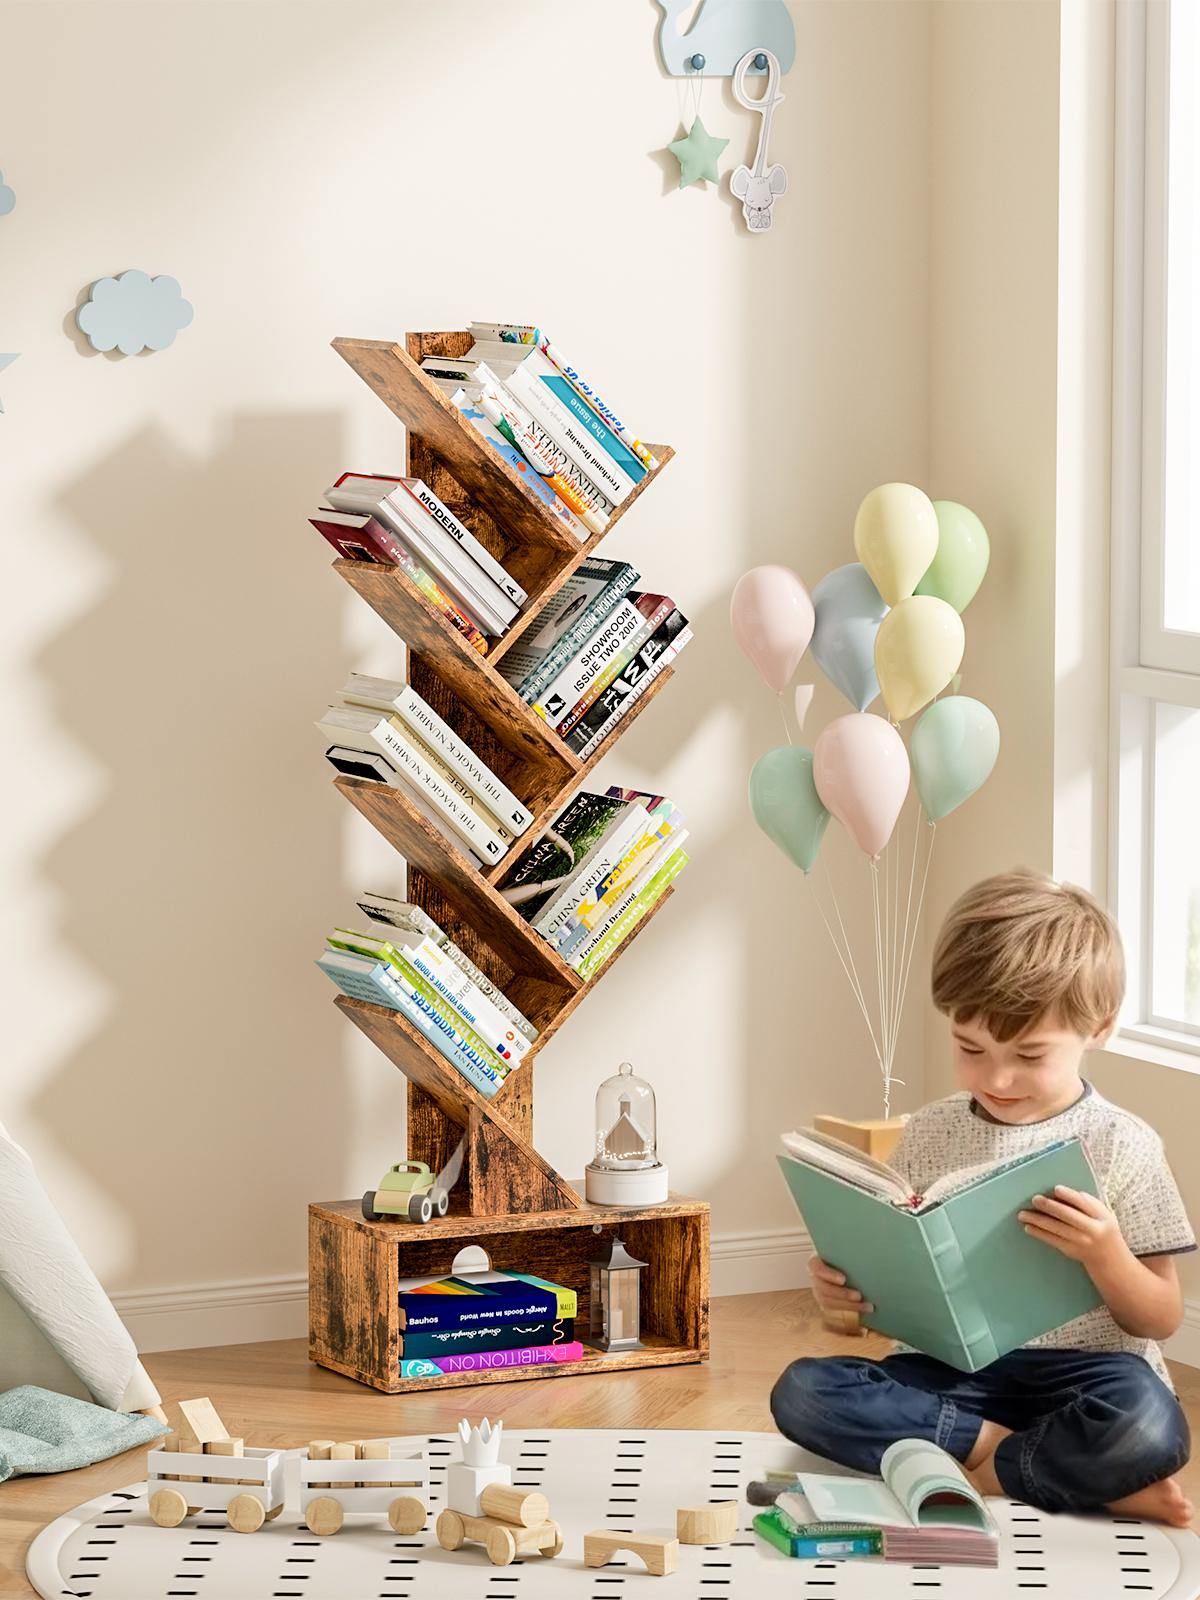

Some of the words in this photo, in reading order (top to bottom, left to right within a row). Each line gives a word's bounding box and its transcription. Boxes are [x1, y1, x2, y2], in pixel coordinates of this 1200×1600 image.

[580, 380, 593, 396] for
[570, 398, 593, 422] issue
[593, 396, 626, 433] Textiles
[528, 421, 568, 466] GREEN
[565, 428, 592, 461] Drawing
[591, 420, 606, 440] the
[570, 463, 608, 510] CHINA
[590, 458, 620, 492] Freehand
[419, 492, 464, 540] MODERN
[506, 584, 517, 596] A
[593, 568, 642, 617] MATHEMATICAL
[573, 611, 600, 642] MOSAIC
[580, 607, 632, 668] SHOWROOM
[628, 632, 647, 654] Pink
[646, 606, 669, 631] Floyd
[574, 663, 600, 692] ISSUE
[598, 641, 620, 664] TWO
[619, 616, 638, 640] 2007
[408, 702, 446, 744] NUMBER
[384, 734, 422, 776] NUMBER
[446, 742, 482, 782] MAGICK
[422, 773, 458, 812] MAGICK
[444, 773, 476, 806] VIBE
[483, 782, 502, 802] THE
[458, 812, 477, 832] THE
[515, 842, 552, 882] CHINA
[548, 898, 580, 934] CHINA
[580, 858, 612, 896] GREEN
[580, 922, 612, 960] Freehand
[609, 892, 637, 926] Drawing
[414, 958, 432, 978] 10000
[441, 941, 503, 1005] ARCHITECTURE
[434, 976, 448, 994] LOVE
[446, 990, 460, 1005] YOU
[411, 991, 456, 1040] WORKERS
[457, 1003, 476, 1024] WORLD
[454, 1050, 466, 1066] IAN
[466, 1062, 485, 1082] HUNT
[457, 1036, 498, 1082] NEUTRAL
[409, 1316, 438, 1326] Bauhos
[506, 1308, 524, 1316] Goods
[526, 1306, 548, 1314] Alergic
[450, 1330, 476, 1340] Simple
[478, 1328, 502, 1336] Single
[450, 1355, 476, 1371] ON
[480, 1346, 566, 1367] EXHIBITION
